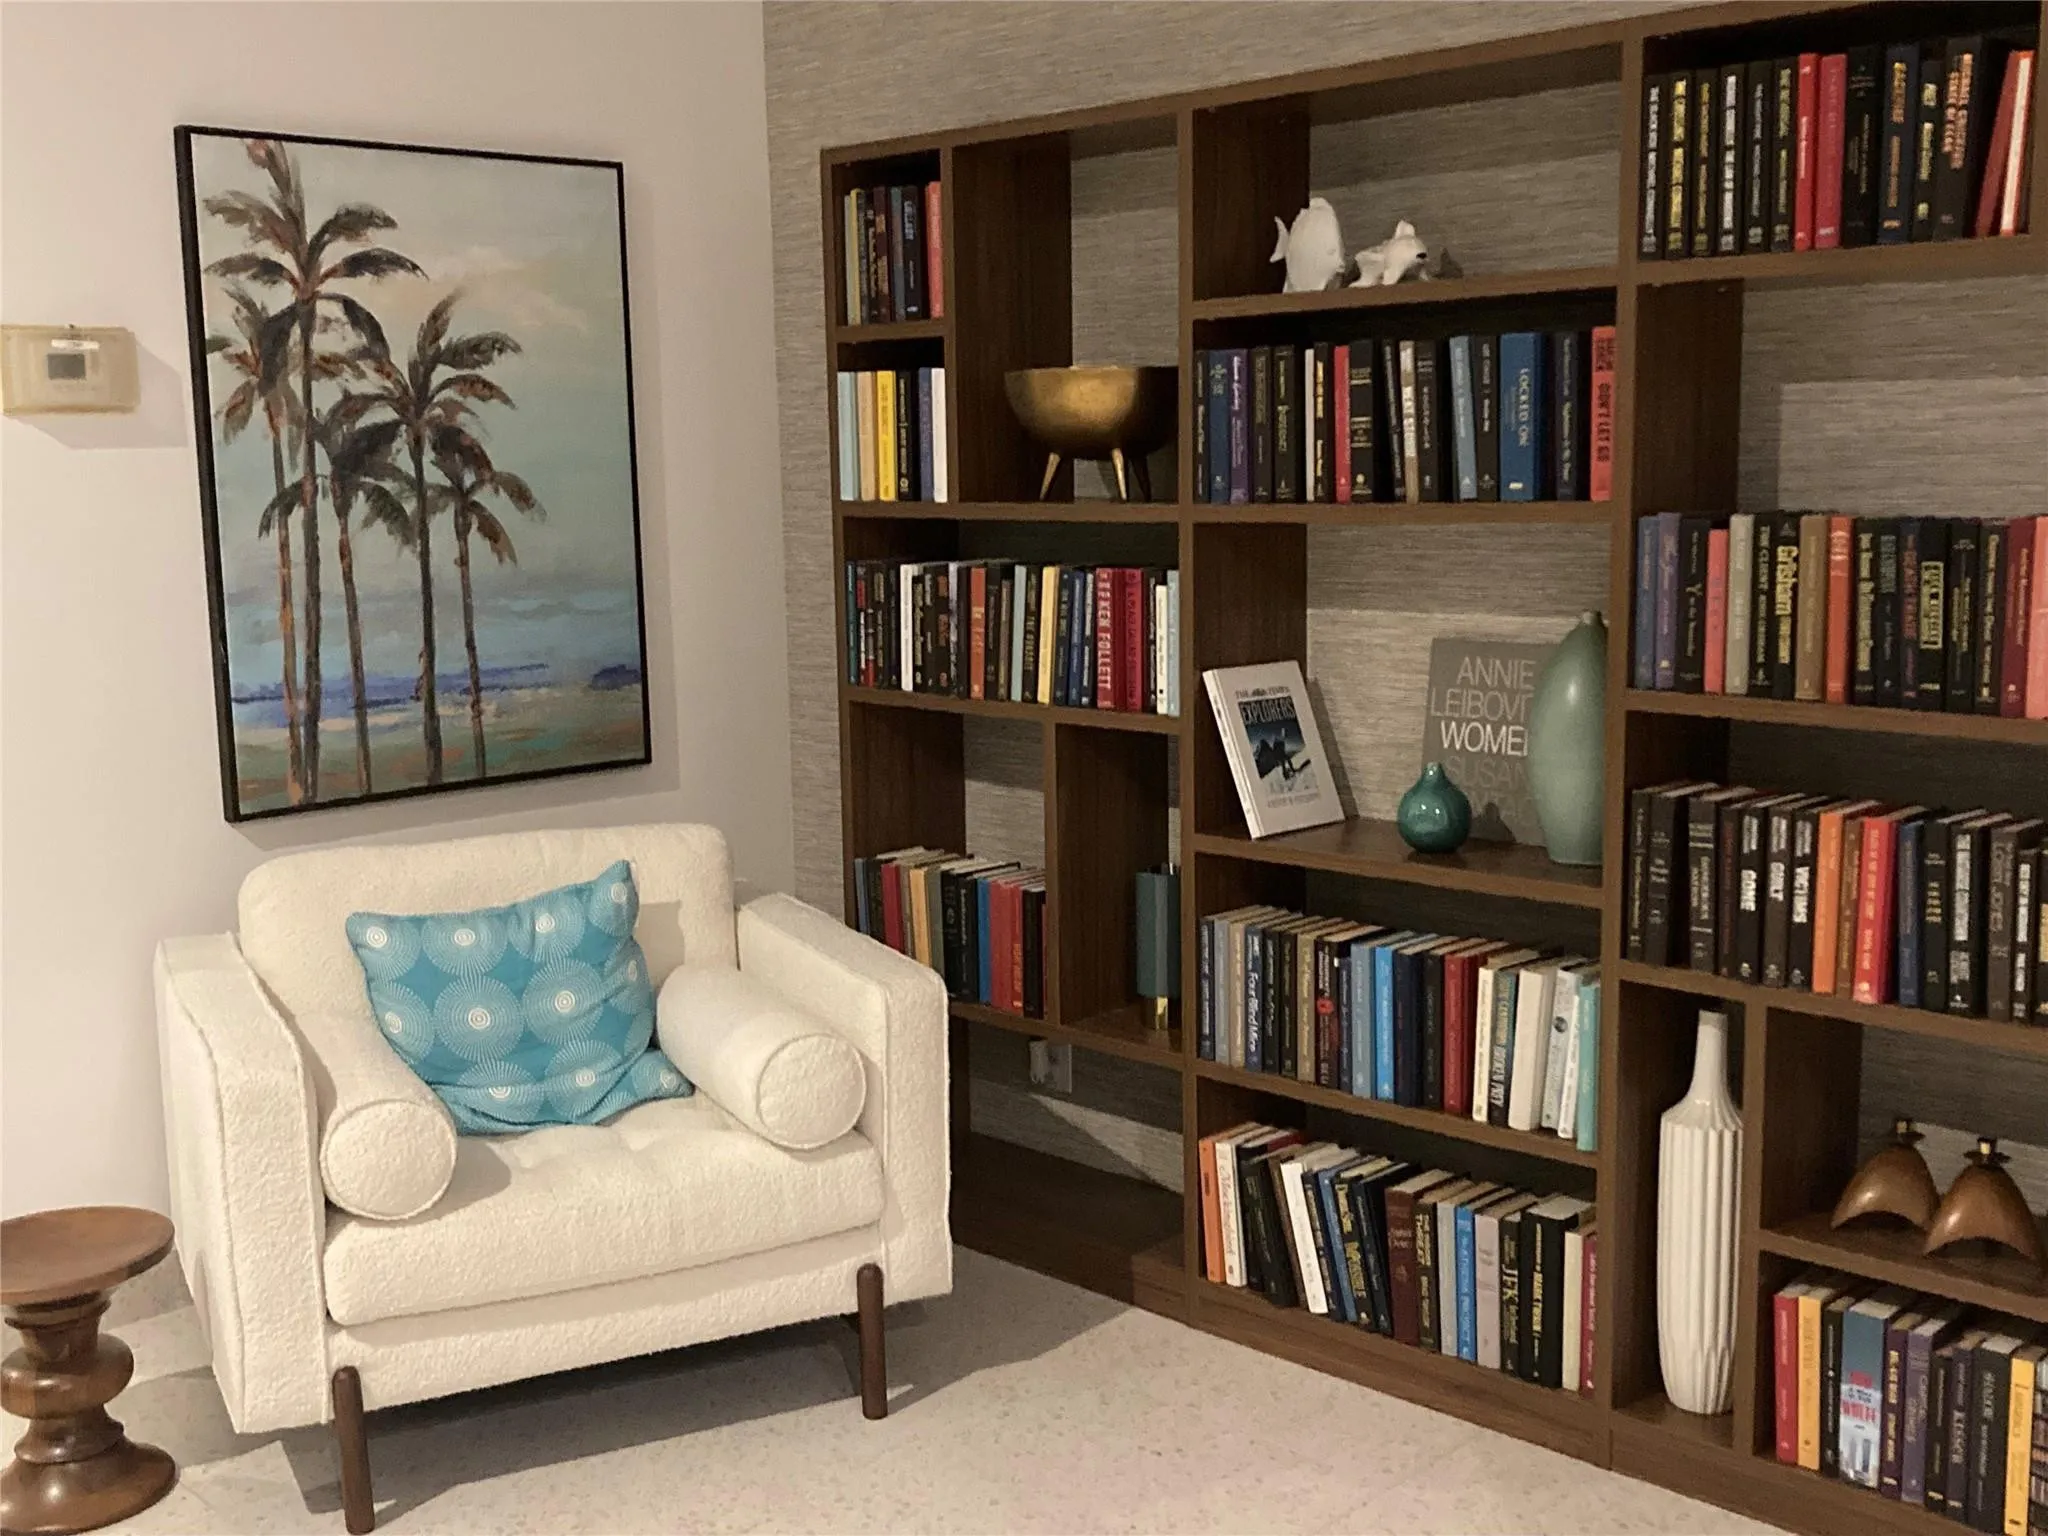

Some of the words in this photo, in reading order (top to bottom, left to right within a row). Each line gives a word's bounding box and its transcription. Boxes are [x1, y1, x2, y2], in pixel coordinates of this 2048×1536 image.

[1517, 368, 1532, 422] LOCKED
[1517, 424, 1531, 448] ON
[1758, 549, 1770, 591] CLIENT
[1775, 545, 1799, 616] Grisham
[1684, 582, 1703, 597] Y
[1096, 599, 1112, 628] KEN
[1096, 632, 1112, 691] FOLLETT
[1456, 655, 1537, 691] ANNIE
[1238, 696, 1297, 725] EXPLORERS
[1740, 869, 1757, 913] GONE
[1792, 866, 1811, 924] VICTIMS
[1248, 972, 1258, 997] Four
[1247, 1025, 1259, 1053] Mice
[1490, 1081, 1505, 1108] PREY
[1501, 1263, 1518, 1304] JFK
